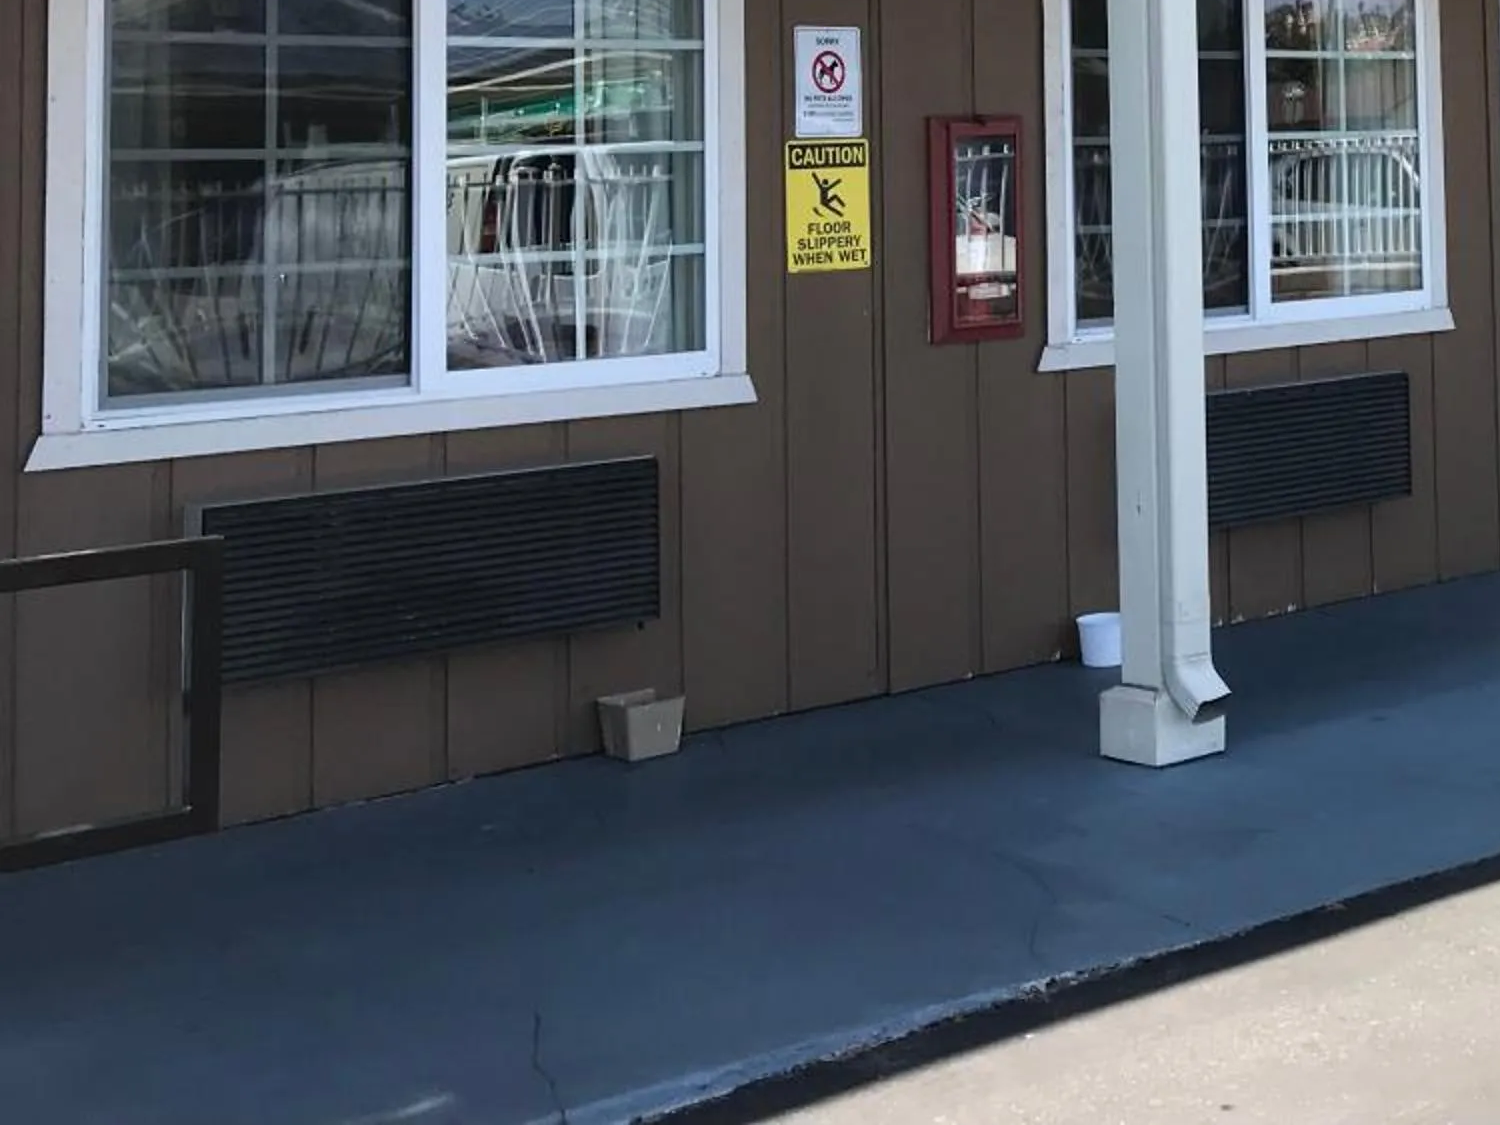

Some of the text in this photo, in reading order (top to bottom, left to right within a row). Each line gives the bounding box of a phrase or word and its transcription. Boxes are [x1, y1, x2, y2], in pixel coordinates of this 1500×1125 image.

[791, 146, 863, 165] CAUTION
[808, 221, 851, 235] FLOOR
[797, 235, 862, 251] SLIPPERY
[792, 248, 867, 266] WHEN WET
